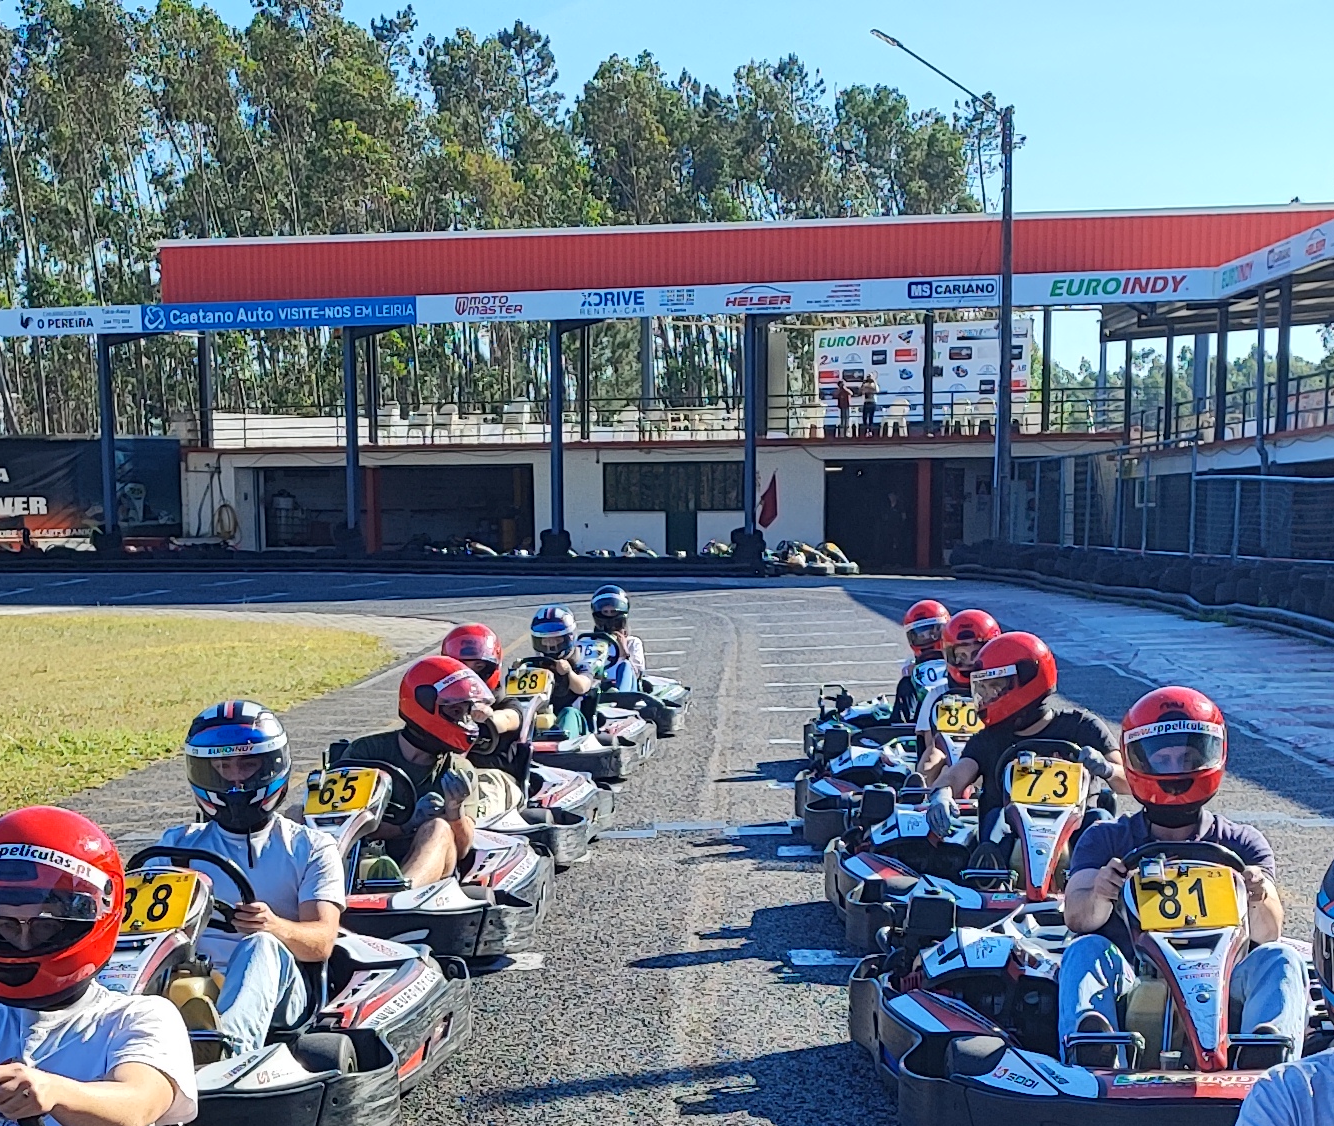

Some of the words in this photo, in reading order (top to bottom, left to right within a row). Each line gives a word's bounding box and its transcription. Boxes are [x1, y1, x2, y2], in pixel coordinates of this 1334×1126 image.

[910, 284, 931, 297] MS
[1049, 274, 1187, 297] EUROINDY
[582, 290, 645, 307] XDRIVE
[724, 294, 792, 307] HELSER
[169, 306, 234, 325] Caetano
[236, 306, 274, 323] Auto
[278, 304, 352, 321] VISITE-NOS
[353, 304, 374, 319] EM
[374, 302, 415, 318] LEIRIA
[579, 306, 645, 316] RENT-A-CAR
[36, 318, 45, 329] O
[47, 317, 95, 329] PEREIRA
[818, 333, 891, 348] EUROINDY
[518, 673, 539, 691] 68
[946, 707, 979, 727] 80
[317, 776, 358, 806] 65
[1025, 769, 1070, 799] 73
[1158, 877, 1208, 920] 81
